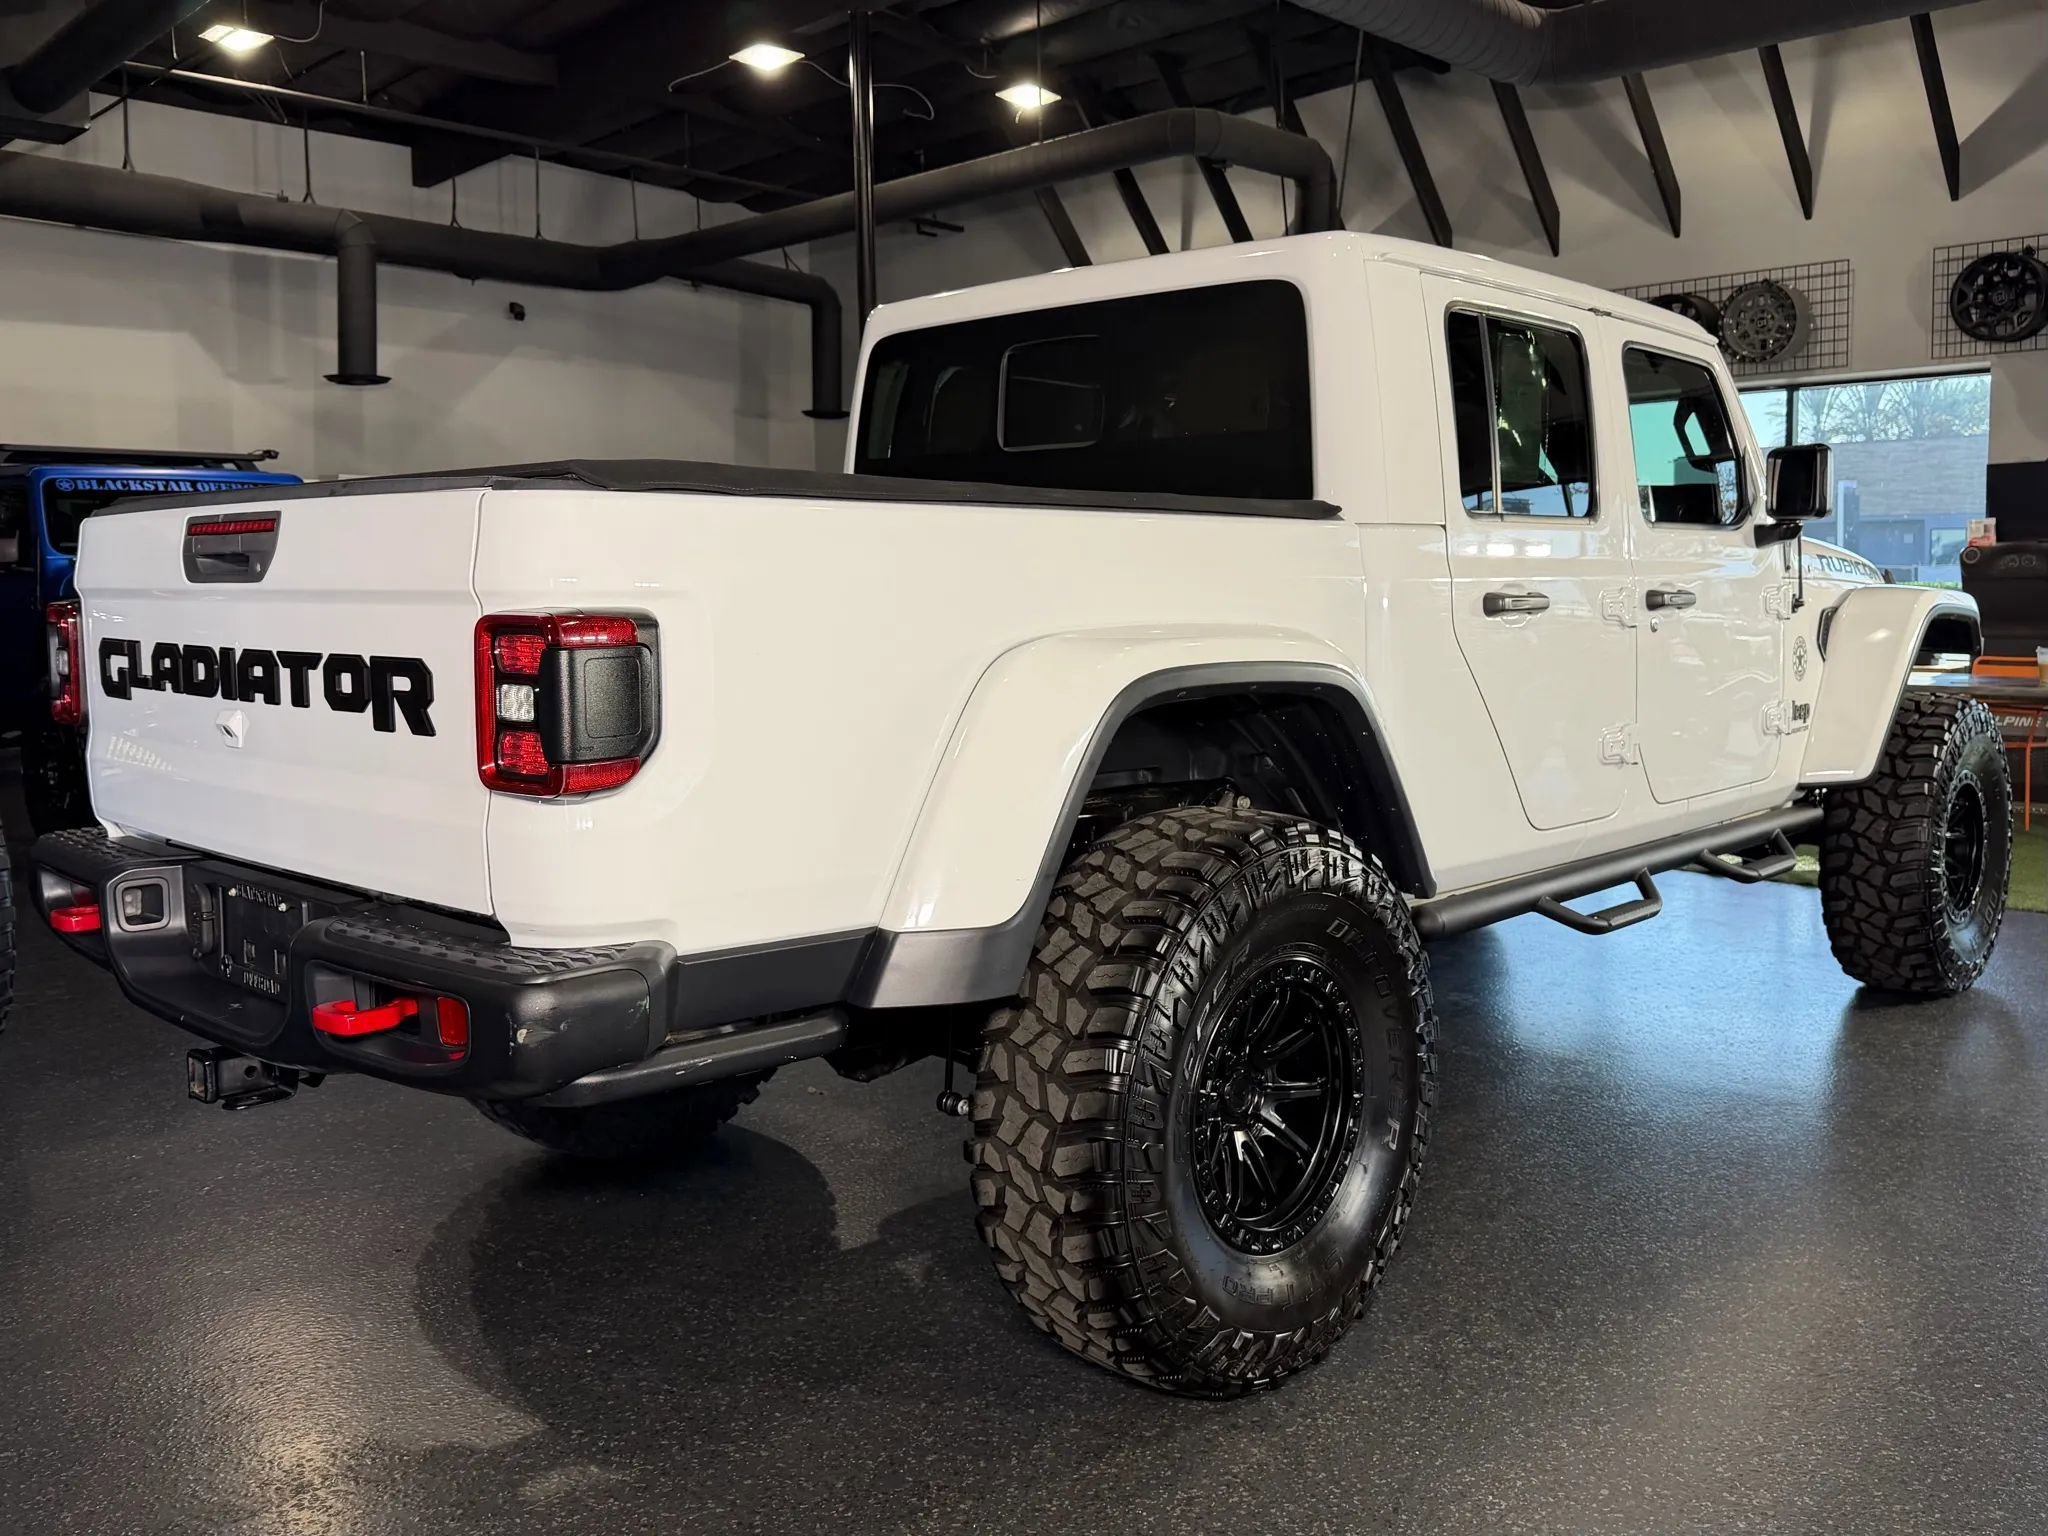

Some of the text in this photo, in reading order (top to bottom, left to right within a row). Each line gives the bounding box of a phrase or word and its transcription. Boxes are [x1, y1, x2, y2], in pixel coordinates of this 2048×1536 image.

[76, 479, 264, 493] BLACKSTAR OFFRO
[1816, 554, 1881, 579] RUBICON
[98, 637, 436, 737] GLADIATOR
[1994, 715, 2043, 728] LPINE
